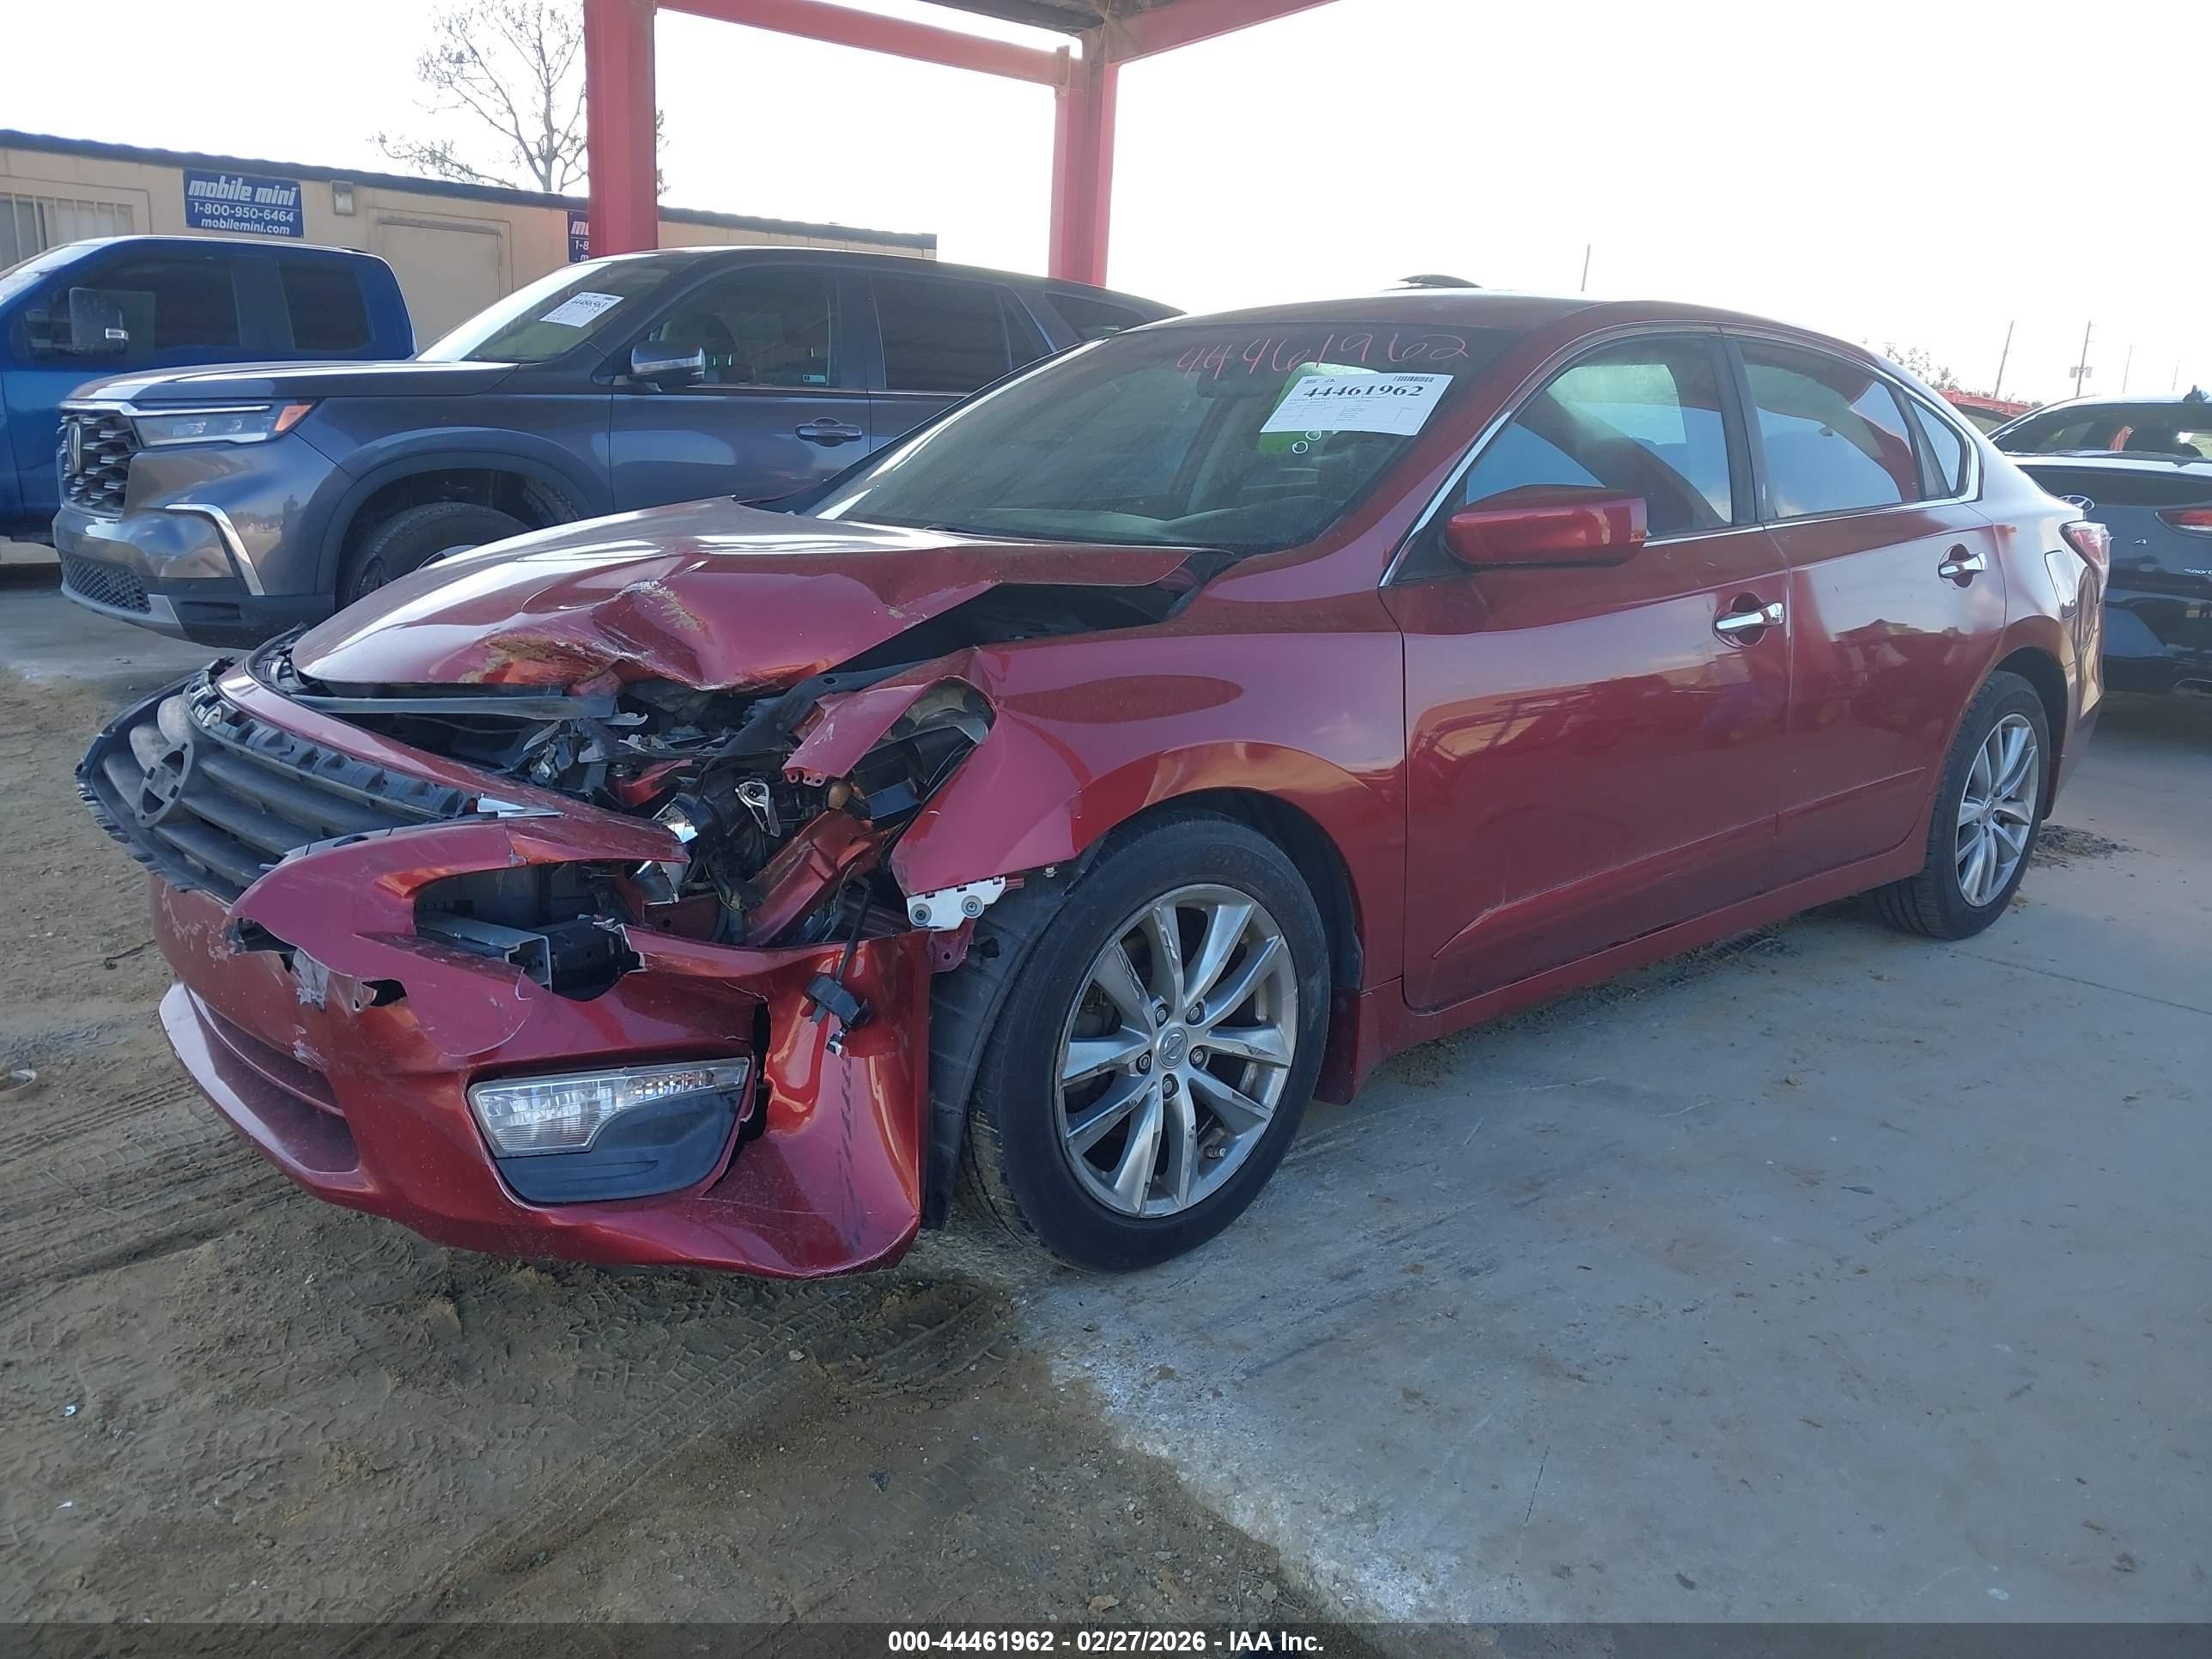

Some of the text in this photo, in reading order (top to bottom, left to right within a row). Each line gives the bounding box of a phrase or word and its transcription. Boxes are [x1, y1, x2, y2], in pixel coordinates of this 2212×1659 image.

[188, 175, 296, 206] mobile mini
[193, 202, 295, 222] 1-800-950-6464
[201, 216, 290, 235] mobilemini.com
[1303, 384, 1425, 398] 44461962
